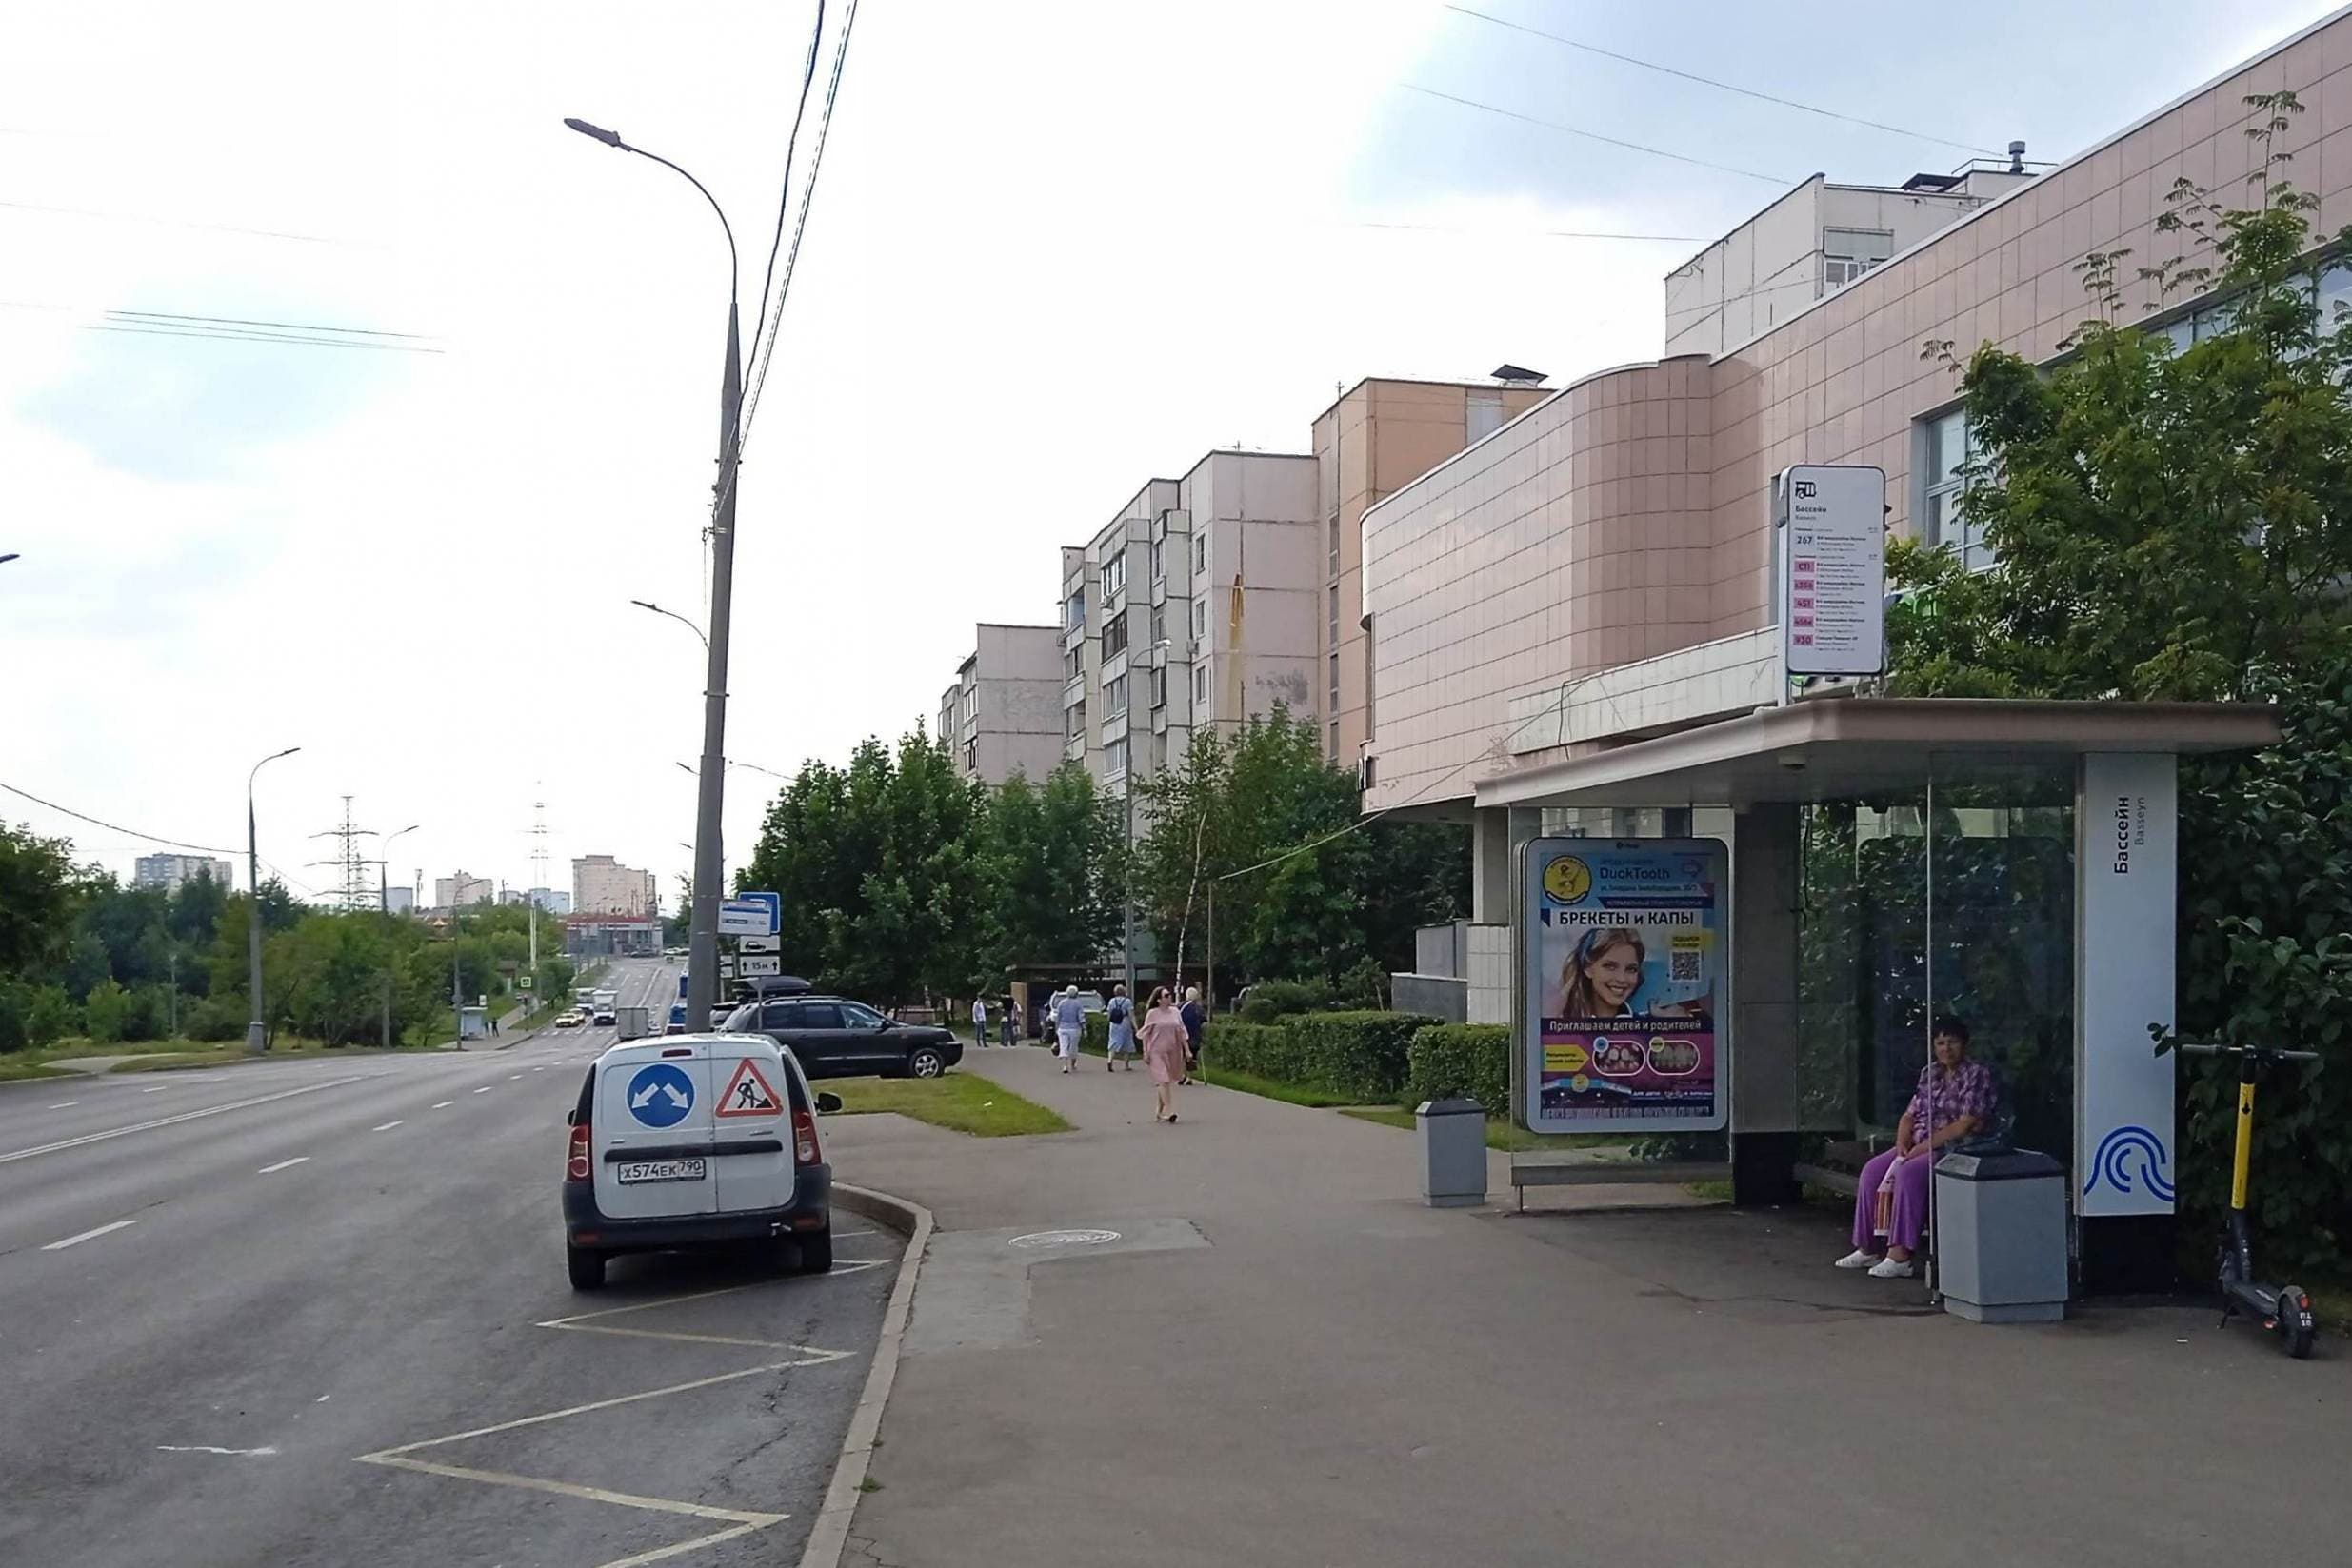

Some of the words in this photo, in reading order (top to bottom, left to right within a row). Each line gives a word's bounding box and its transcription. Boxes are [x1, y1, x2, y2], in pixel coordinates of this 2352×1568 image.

[1795, 505, 1827, 513] Бассейн
[1797, 536, 1813, 546] 267
[2134, 797, 2147, 846] Basseyn
[2113, 797, 2129, 874] Бассейн
[1599, 866, 1670, 880] DuckTooth
[1559, 911, 1629, 925] БРЕКЕТЫ
[1634, 914, 1644, 924] и
[1648, 911, 1694, 925] КАПЫ
[1549, 1021, 1612, 1032] Приглашаем
[1613, 1020, 1641, 1032] детей
[1643, 1022, 1649, 1030] и
[1650, 1020, 1702, 1032] родителей
